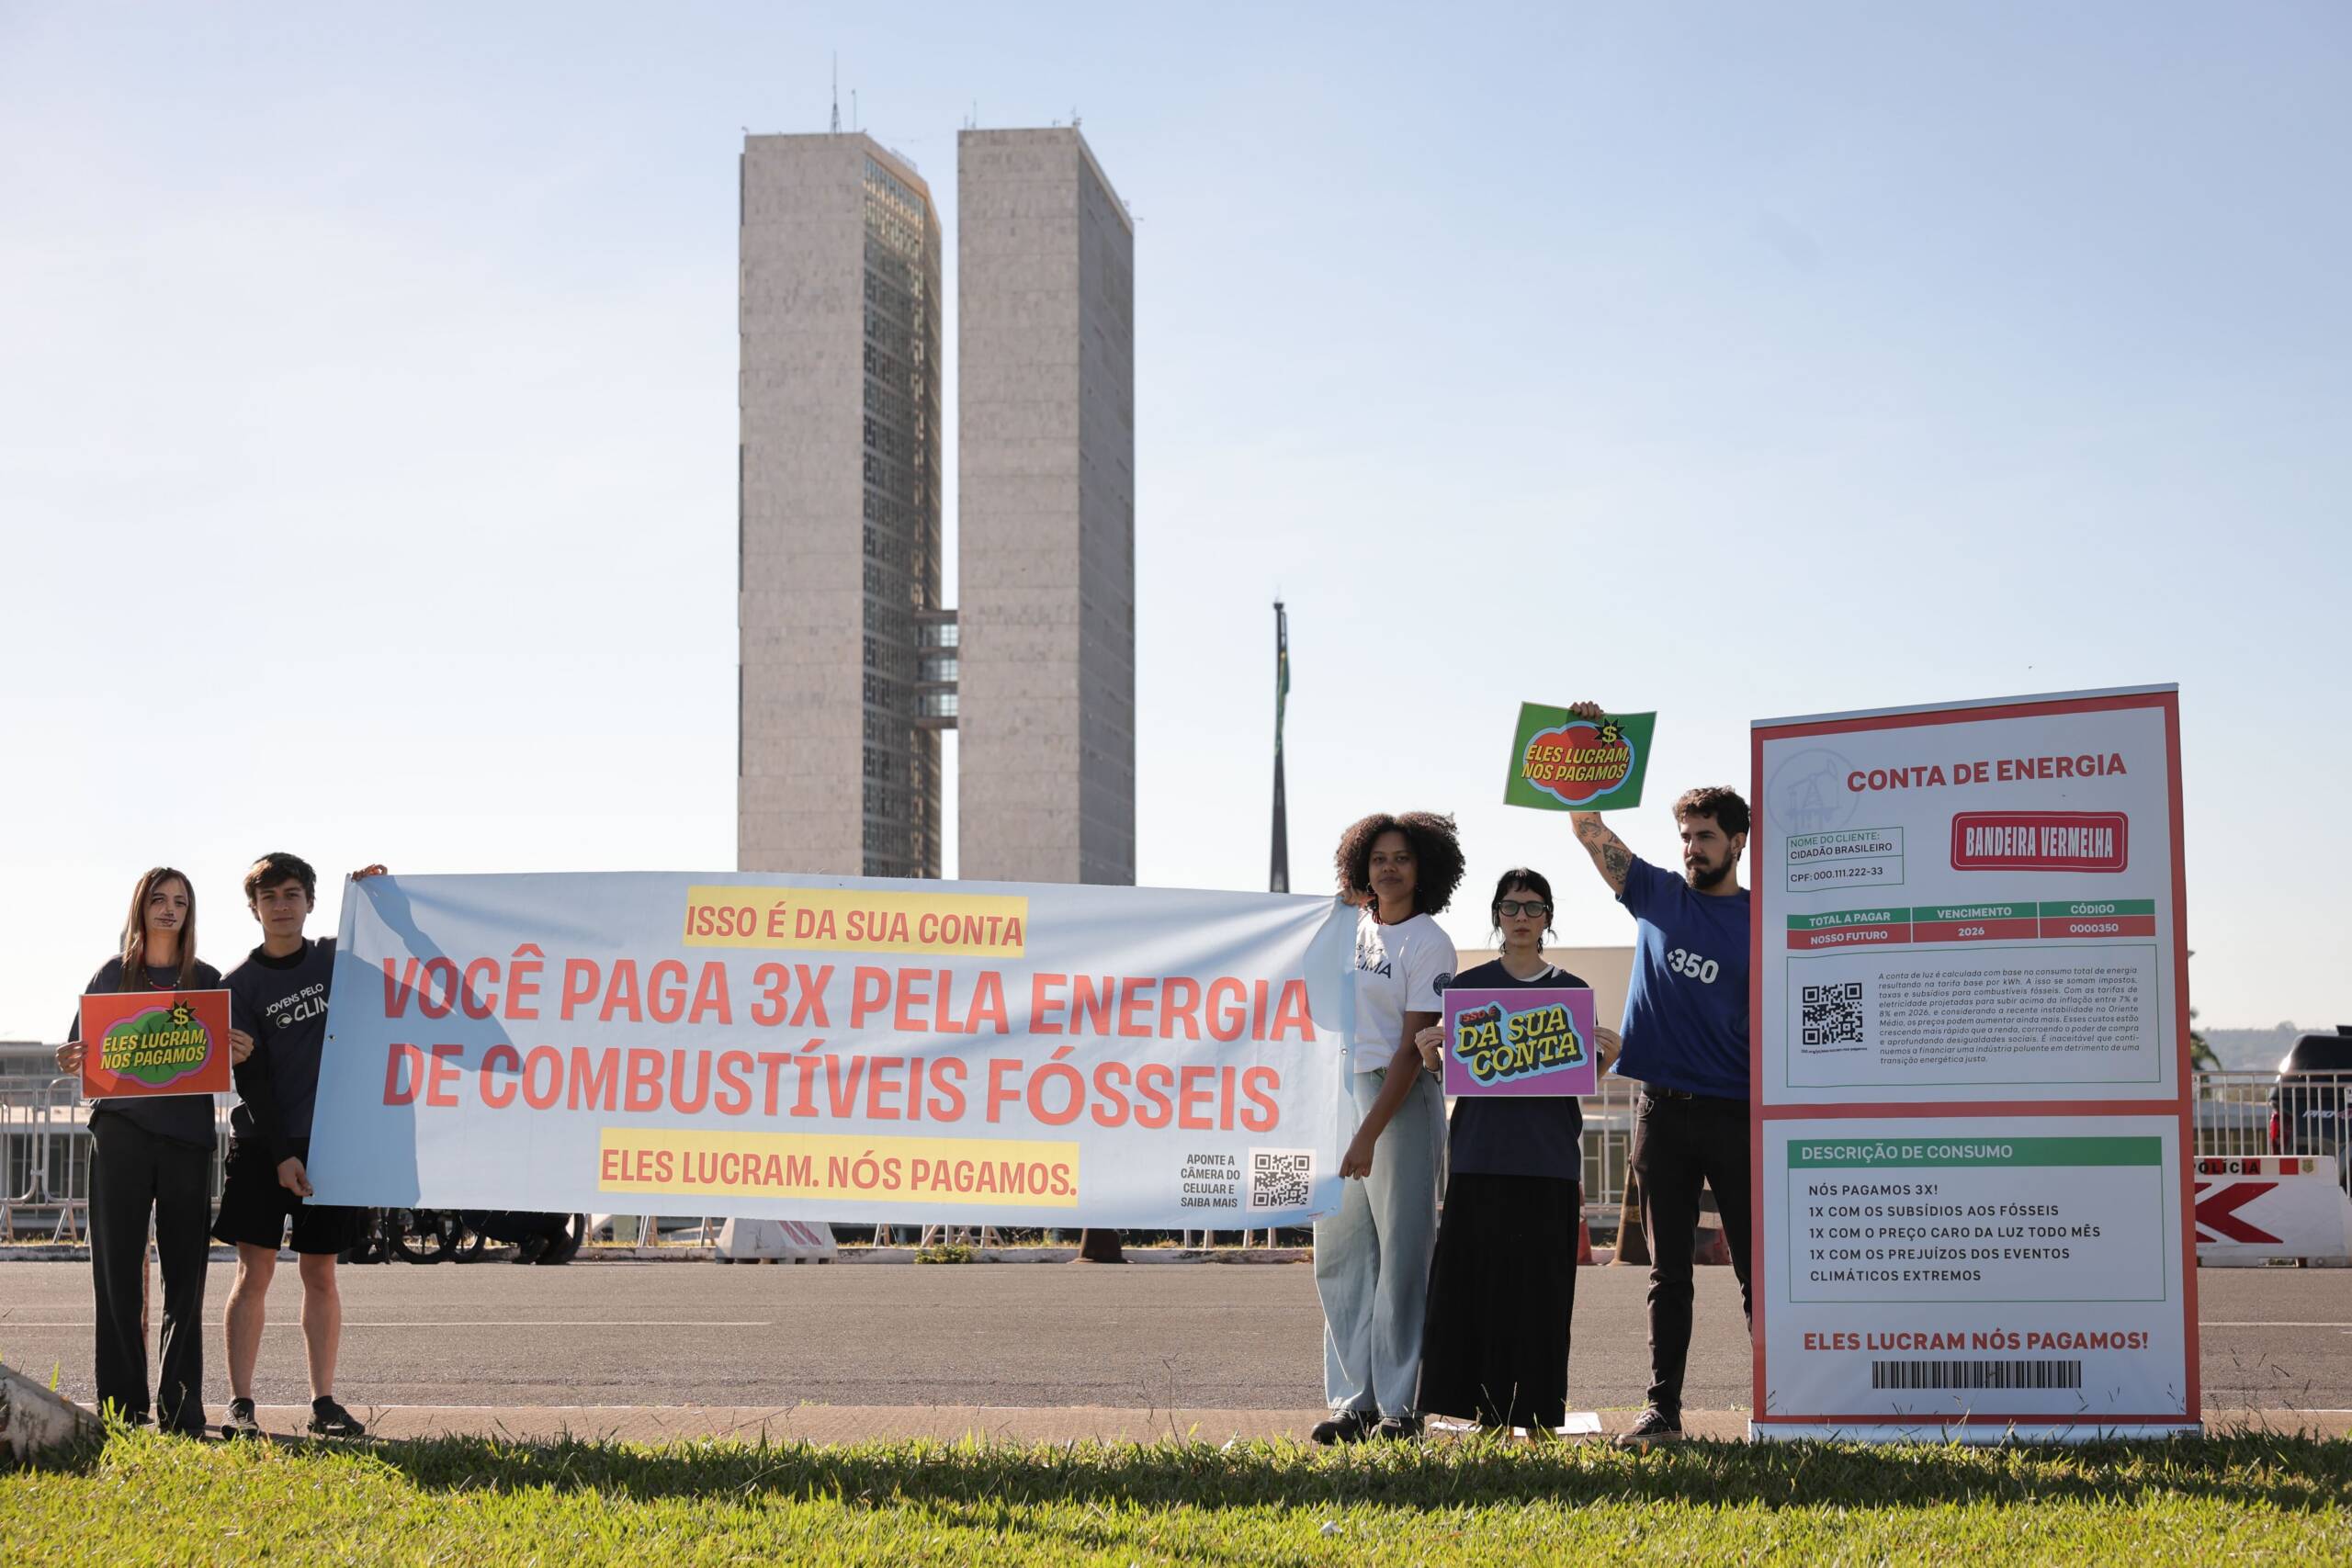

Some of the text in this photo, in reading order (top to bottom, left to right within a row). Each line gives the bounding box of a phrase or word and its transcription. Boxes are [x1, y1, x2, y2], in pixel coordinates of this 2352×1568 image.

[1602, 722, 1617, 744] $
[1526, 745, 1630, 764] ELES LUCRAM,
[1555, 763, 1627, 782] PAGAMOS
[1847, 753, 2127, 792] CONTA DE ENERGIA
[1791, 832, 1880, 848] NOME DO CLIENTE:
[1965, 826, 2113, 859] BANDEIRA VERMELHA
[1791, 843, 1893, 859] CIDADÃO BRASILEIRO
[1791, 866, 1883, 883] CPF: 000.111.222-33
[1937, 907, 2012, 919] VENCIMENTO
[2071, 902, 2115, 915] CÓDIGO
[687, 901, 1023, 947] ISSO É DA SUA CONTA
[1809, 912, 1890, 927] TOTAL A PAGAR
[1958, 926, 1984, 937] 2026
[2070, 923, 2119, 934] 0000350
[1810, 931, 1888, 945] NOSSO FUTURO
[1671, 948, 1719, 984] 350
[383, 942, 1317, 1043] VOCÊ PAGA 3X PELA ENERGIA
[1879, 981, 1921, 989] resultando
[1973, 987, 2027, 996] combustíveis
[266, 984, 323, 1016] JOVENS PELO
[1880, 999, 1927, 1009] eletricidade
[1929, 998, 1973, 1007] projetadas
[2060, 997, 2092, 1005] inflação
[174, 1007, 188, 1027] $
[295, 997, 329, 1021] CLIM
[1460, 1010, 1485, 1022] ISSO
[1457, 1008, 1566, 1053] DA SUA
[1943, 1027, 1969, 1035] rápido
[2071, 1024, 2095, 1033] poder
[103, 1029, 208, 1053] ELES LUCRAM,
[1887, 1037, 1944, 1046] aprofundando
[1946, 1036, 2005, 1045] desigualdades
[134, 1046, 205, 1066] PAGAMOS
[1472, 1032, 1577, 1076] CONTA
[1881, 1057, 1918, 1066] transição
[1965, 1055, 1987, 1064] justa.
[383, 1039, 1281, 1132] DE COMBUSTÍVEIS FÓSSEIS
[1187, 1154, 1234, 1166] APONTE A
[1802, 1143, 2013, 1163] DESCRIÇÃO DE CONSUMO
[601, 1148, 1077, 1197] ELES LUCRAM. NÓS PAGAMOS.
[1181, 1168, 1240, 1180] CÂMERA DO
[2194, 1159, 2260, 1174] OLÍCIA
[1183, 1183, 1234, 1194] CELULAR E
[1809, 1182, 1939, 1196] NÓS PAGAMOS 3X!
[1181, 1198, 1238, 1208] SAIBA MAIS
[1809, 1201, 2059, 1218] 1X COM OS SUBSÍDIOS AOS FÓSSEIS
[1809, 1224, 2100, 1242] 1X COM O PREÇO CARO DA LUZ TODO MÊS
[1809, 1245, 2070, 1260] 1X COM OS PREJUÍZOS DOS EVENTOS
[1810, 1267, 1981, 1281] CLIMÁTICOS EXTREMOS
[1804, 1327, 2148, 1350] ELES LUCRAM NÓS PAGAMOS!
